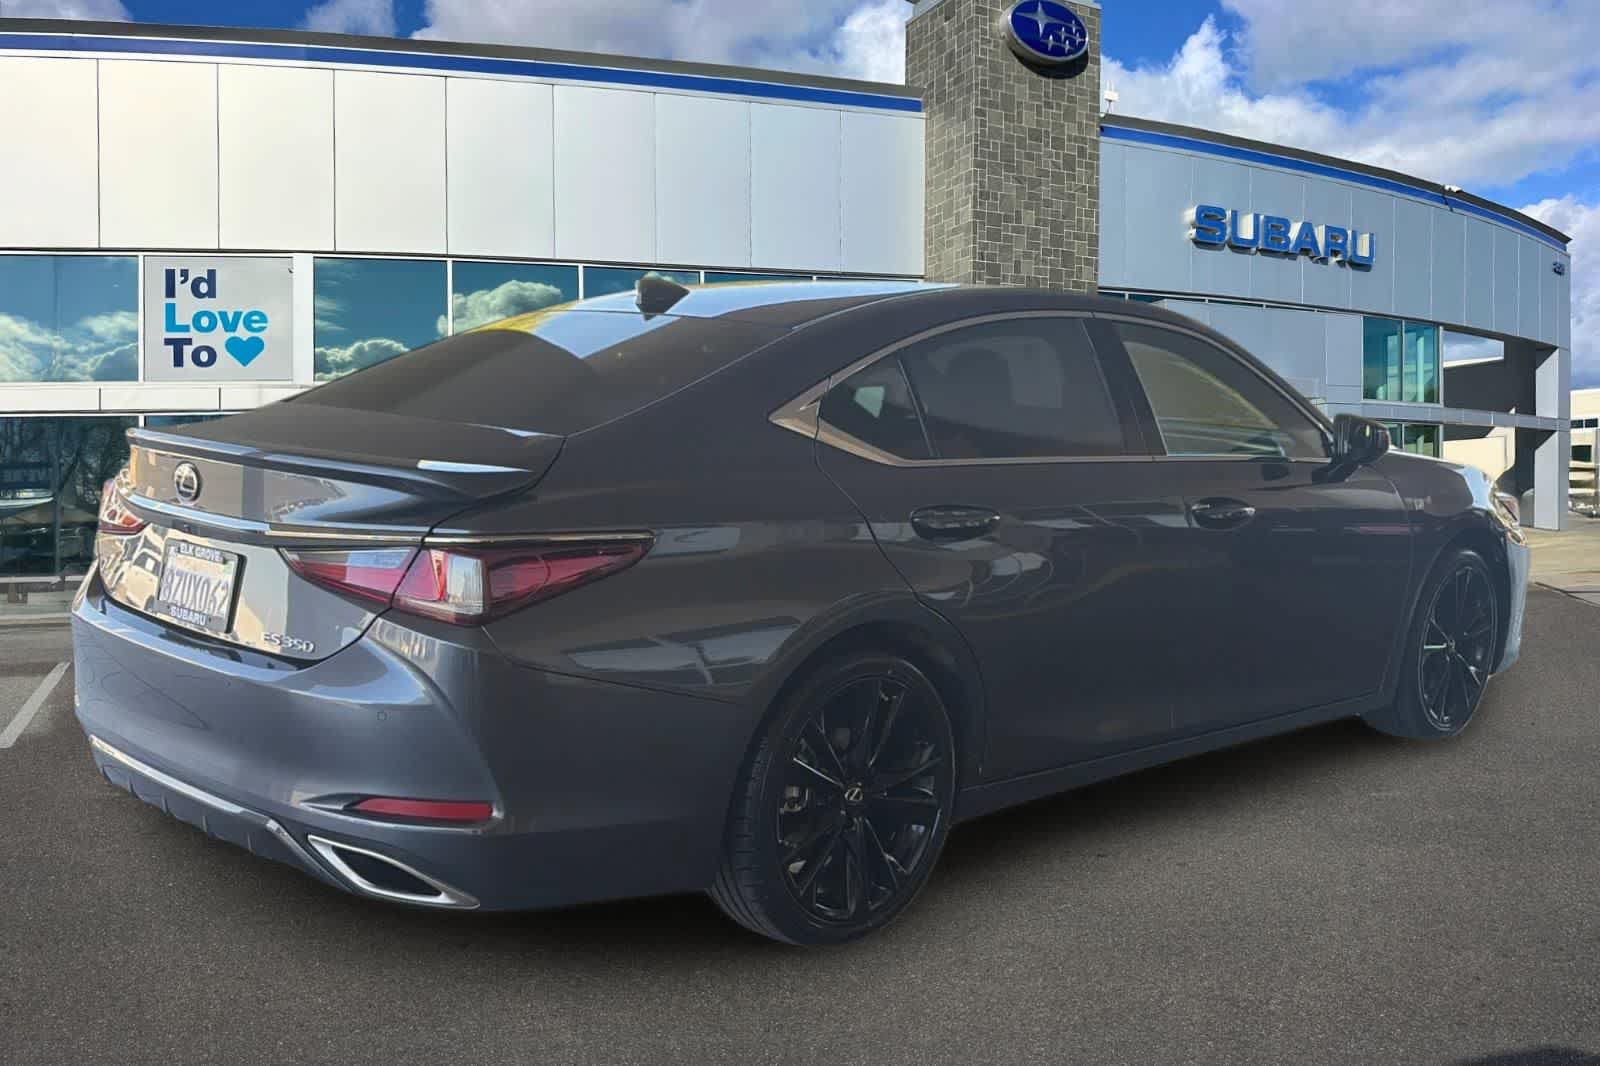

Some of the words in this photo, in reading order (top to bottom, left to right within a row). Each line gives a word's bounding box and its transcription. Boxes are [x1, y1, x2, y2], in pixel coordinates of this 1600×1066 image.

[1189, 204, 1376, 269] SUBARU
[165, 268, 217, 299] I'd
[165, 302, 268, 333] Love
[163, 337, 218, 368] To
[169, 607, 206, 625] SUBARU
